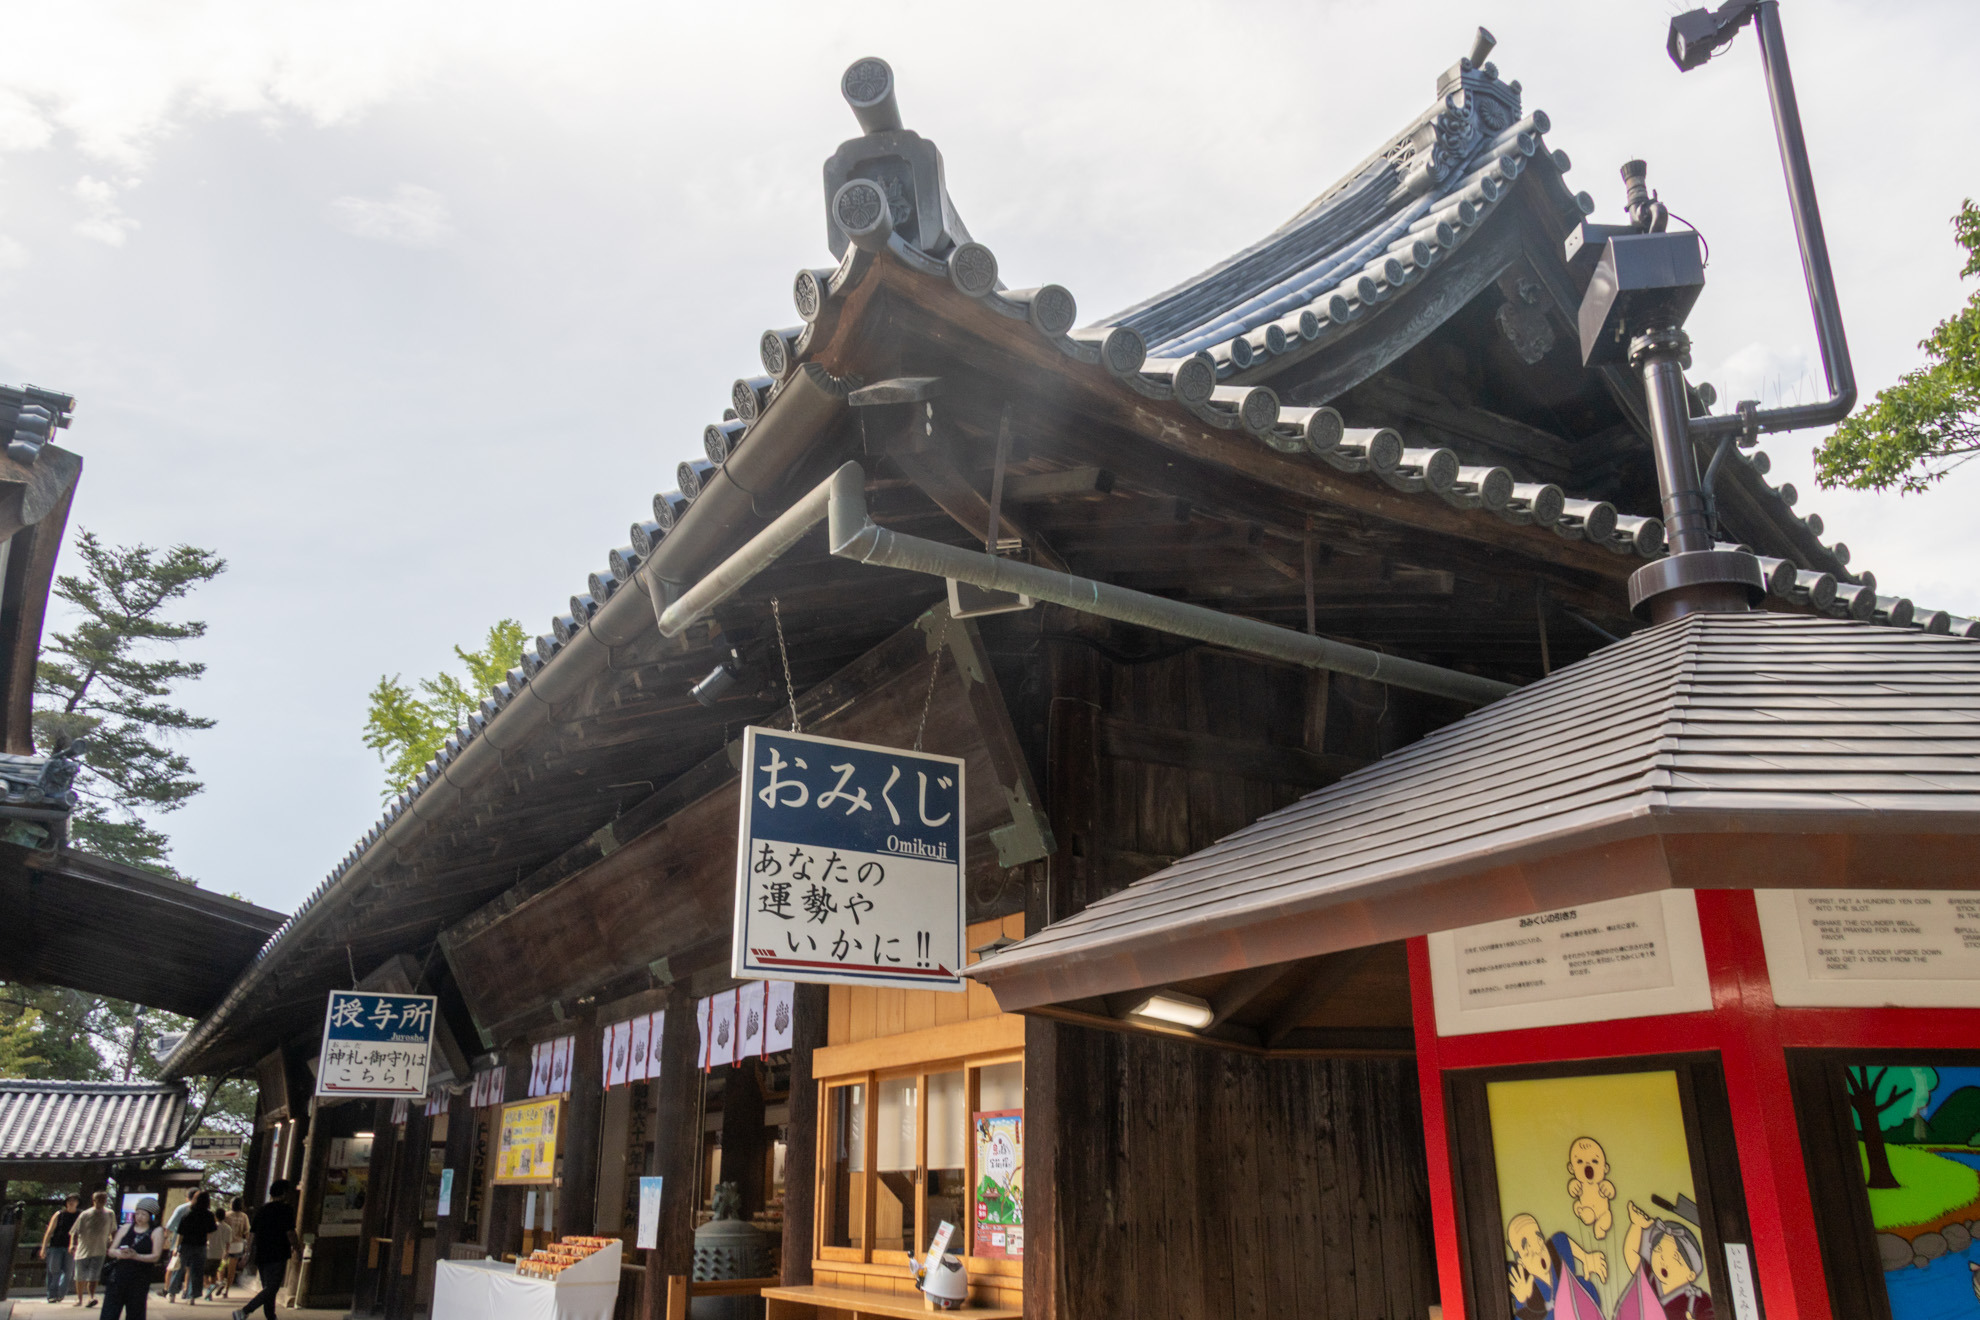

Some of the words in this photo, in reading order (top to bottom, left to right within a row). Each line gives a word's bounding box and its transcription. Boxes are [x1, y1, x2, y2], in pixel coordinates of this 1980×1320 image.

[758, 747, 953, 827] おみくじ
[886, 834, 948, 860] Omikuji
[754, 843, 885, 886] あなたの
[757, 881, 874, 925] 運勢や
[1519, 910, 1577, 928] おみくじの引き方
[330, 998, 432, 1032] 授与所
[328, 1048, 426, 1067] 神札・御守りは
